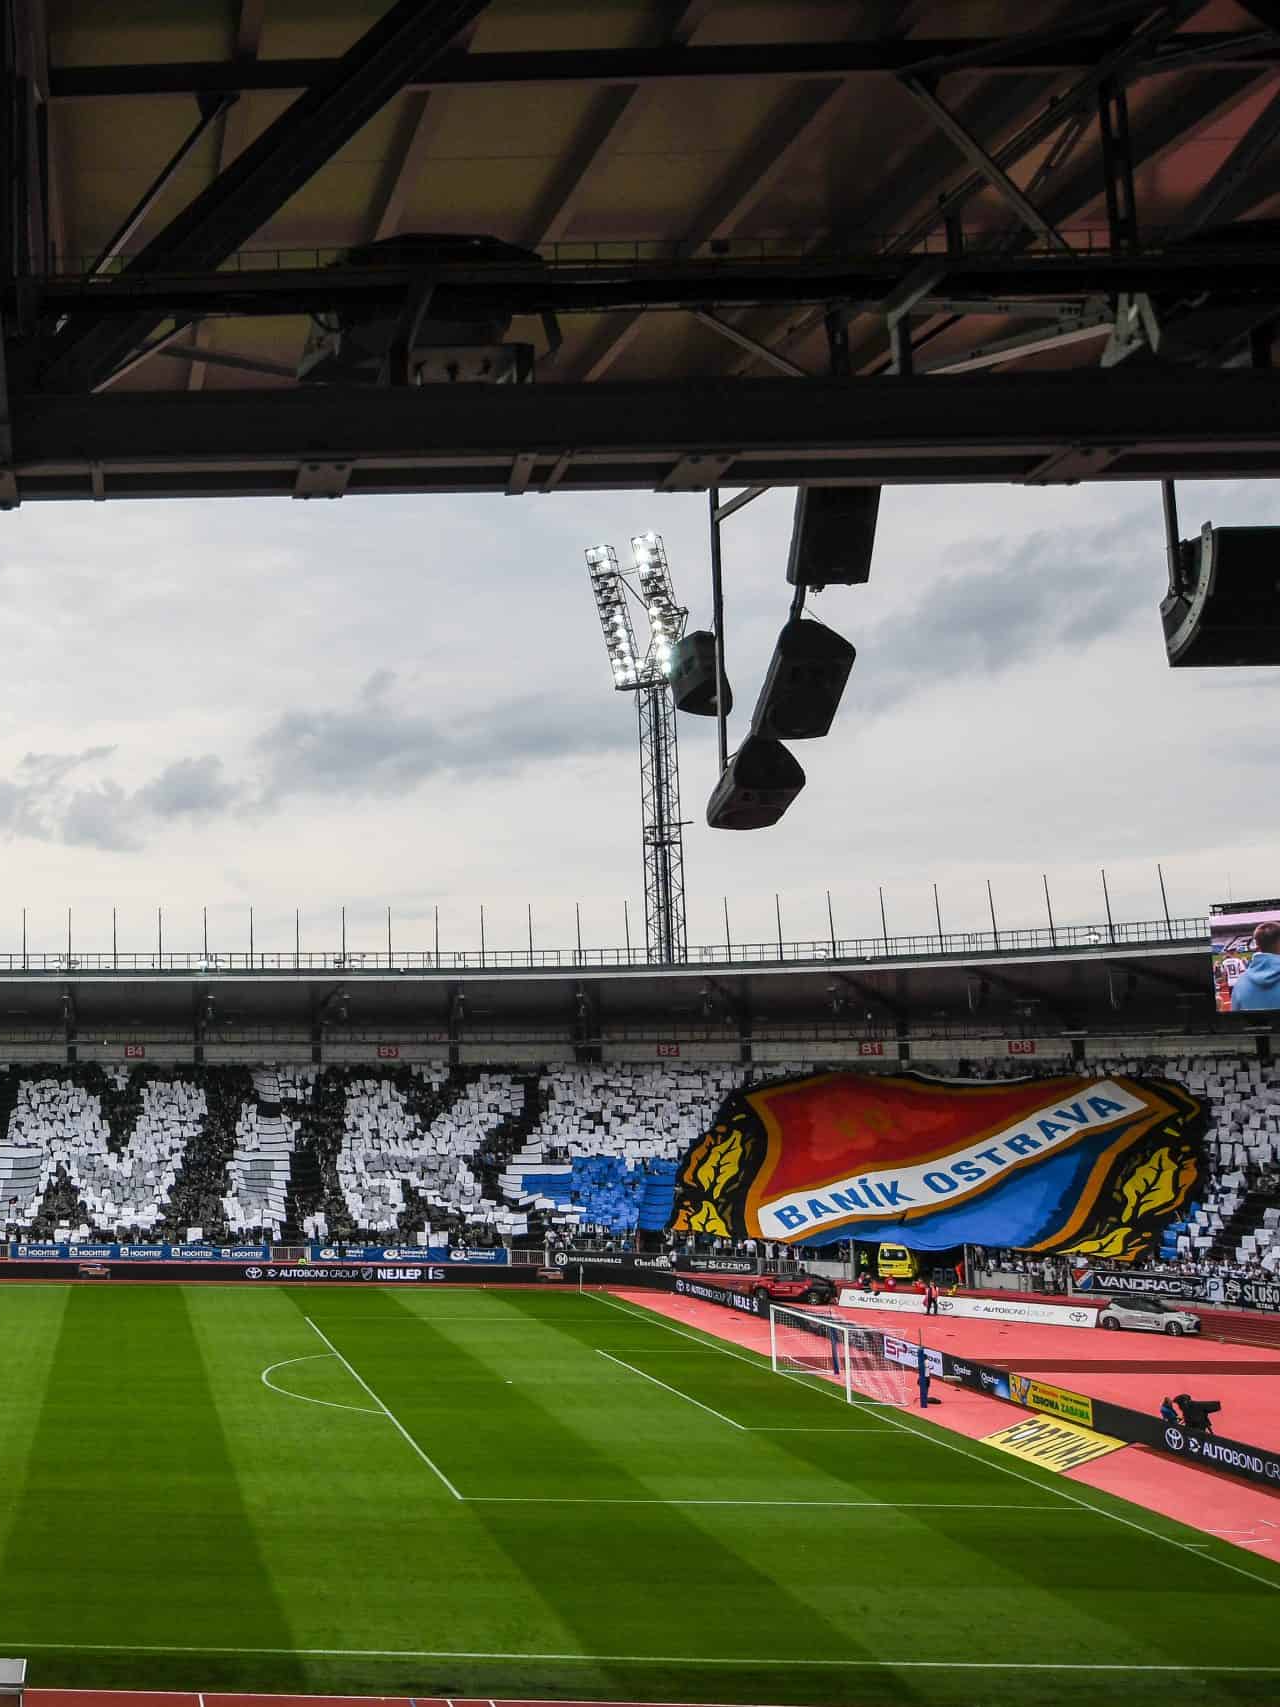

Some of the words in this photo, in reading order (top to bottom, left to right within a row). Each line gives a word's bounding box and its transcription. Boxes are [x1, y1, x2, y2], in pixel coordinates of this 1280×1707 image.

[773, 1177, 913, 1231] BANÍK
[922, 1094, 1126, 1195] OSTRAVA
[279, 1268, 329, 1278] AUTOBOND
[329, 1269, 359, 1278] GROUP
[858, 1296, 897, 1305] AUTOBOND
[983, 1305, 1026, 1316] AUTOBOND
[988, 1419, 1110, 1468] FORTUNA
[1203, 1442, 1263, 1473] AUTOBOND
